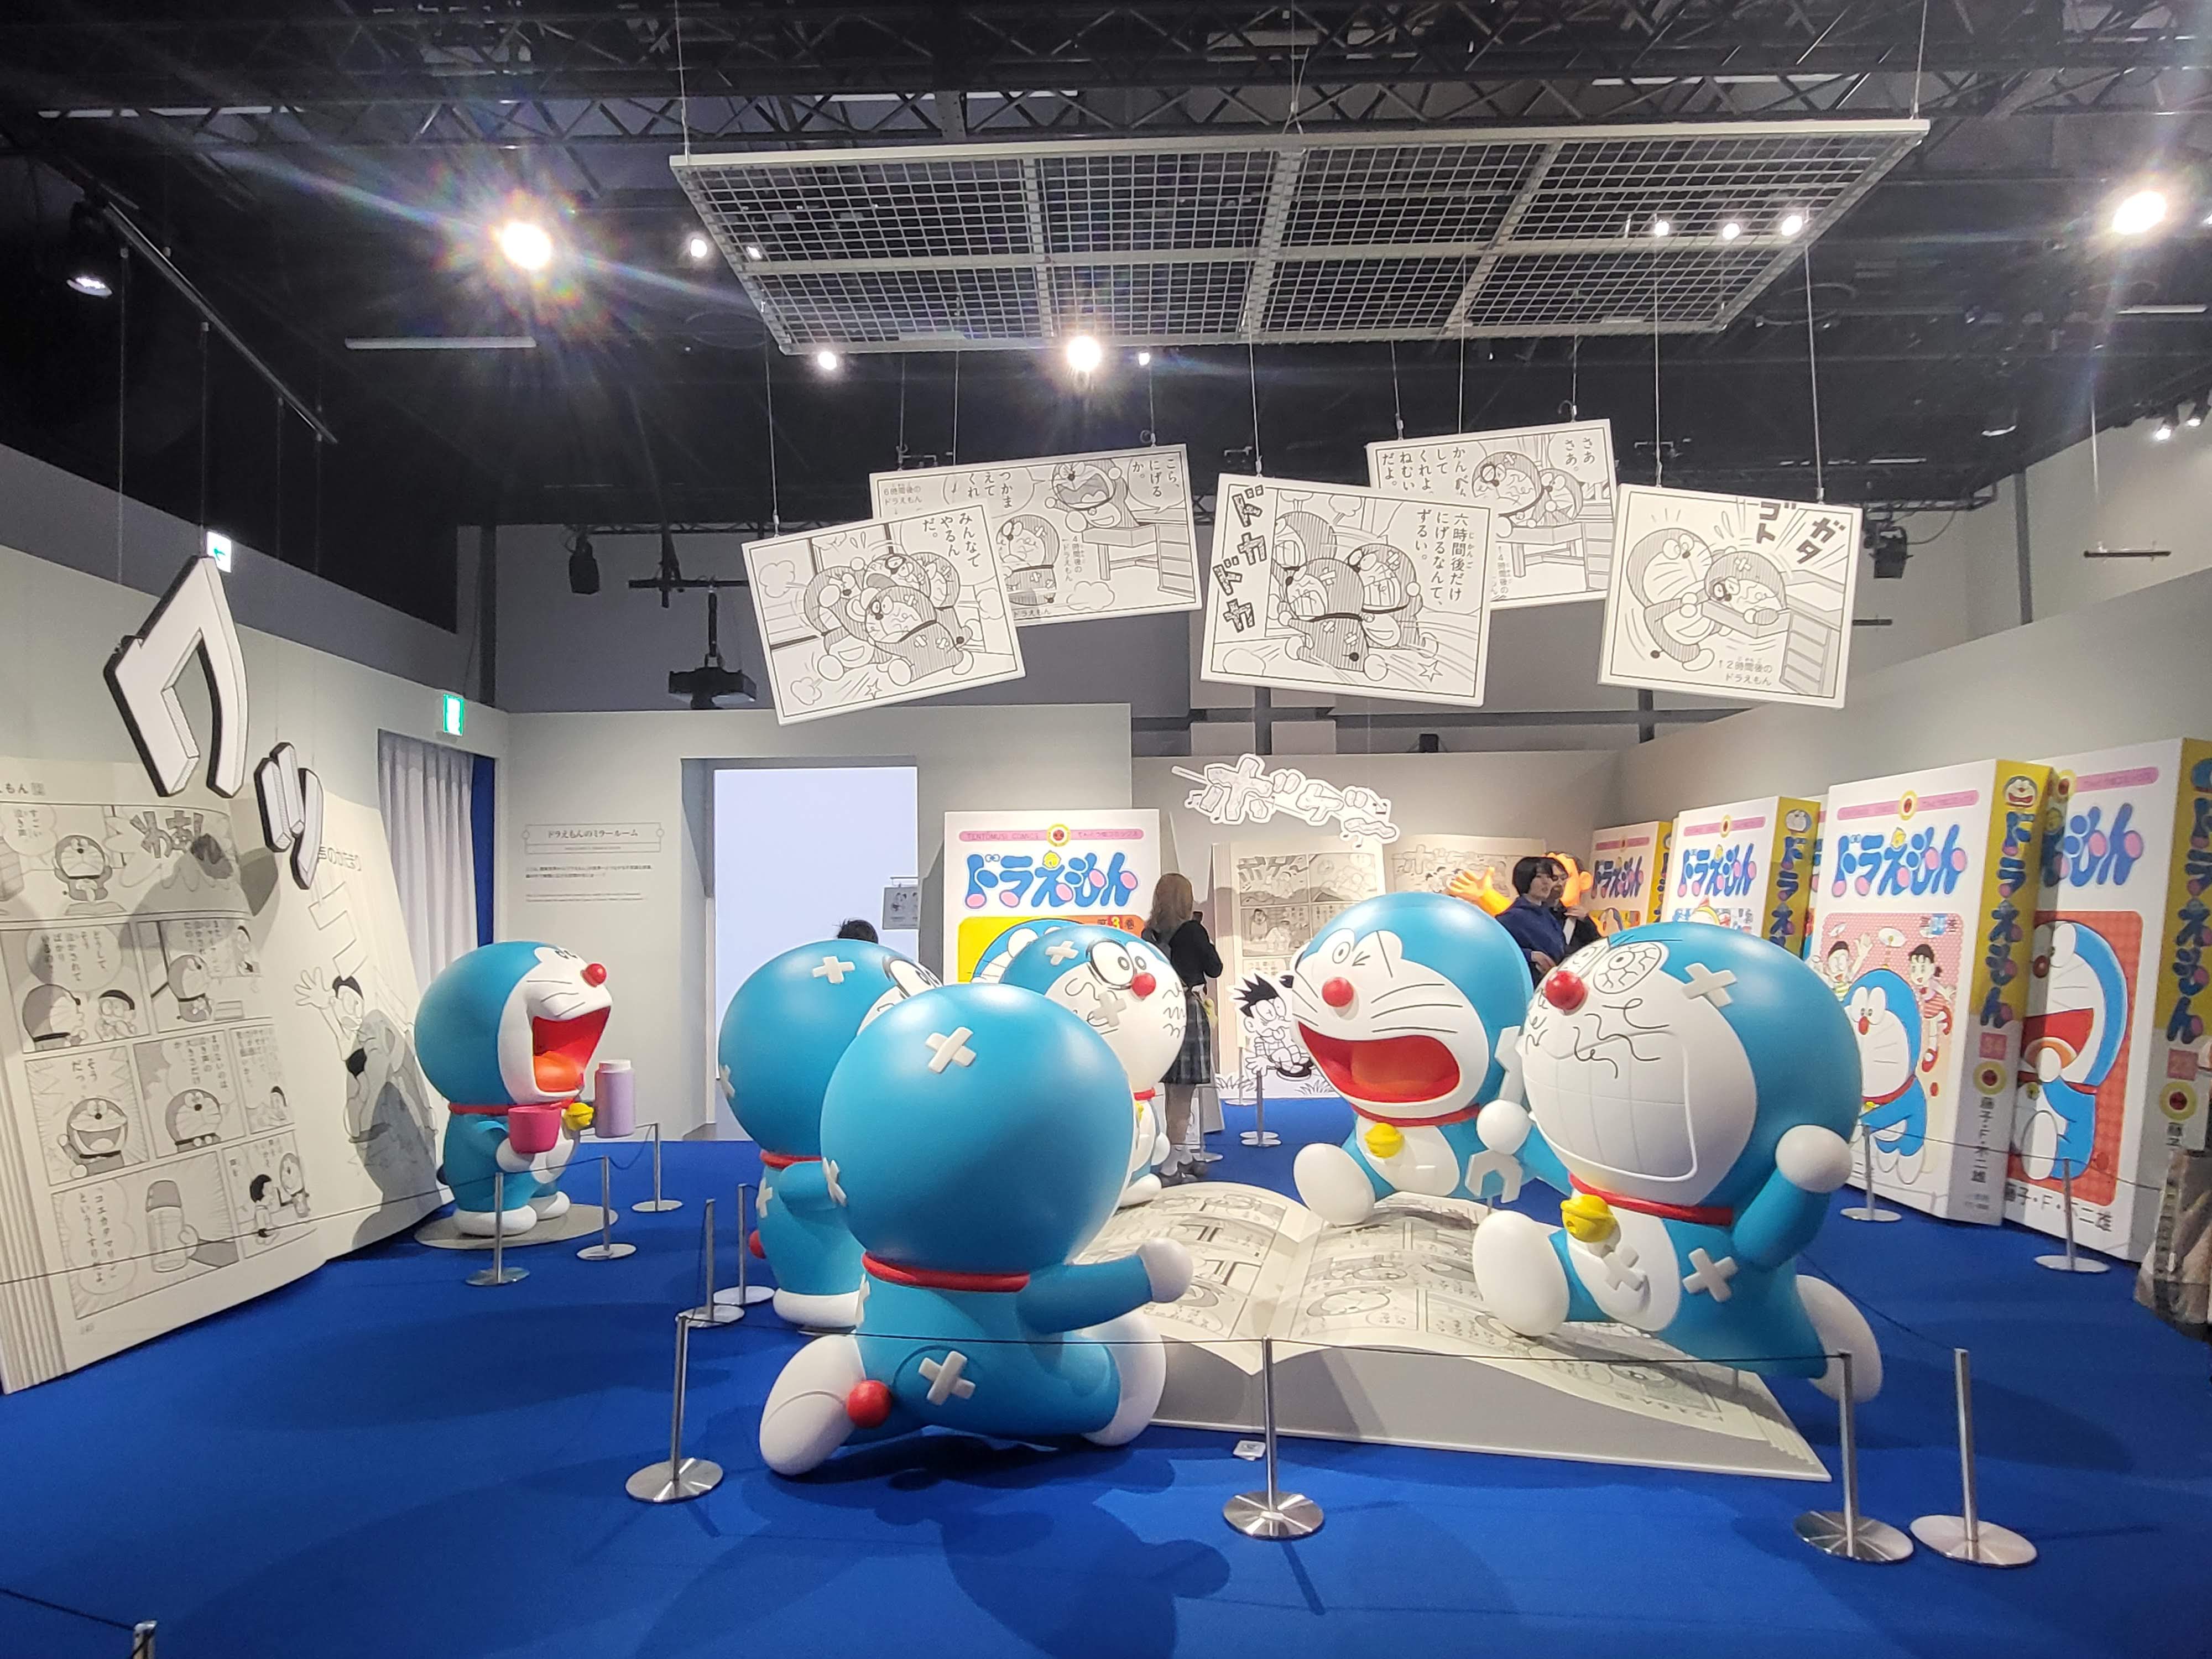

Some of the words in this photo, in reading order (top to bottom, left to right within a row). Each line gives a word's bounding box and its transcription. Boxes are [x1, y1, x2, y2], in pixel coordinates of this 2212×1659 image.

[1132, 461, 1145, 479] か。
[1382, 452, 1397, 487] だよ。
[1436, 448, 1448, 475] して
[1564, 439, 1579, 472] さあ。
[1583, 437, 1595, 465] さあ
[967, 473, 980, 498] くれ
[984, 471, 995, 497] えて
[999, 471, 1013, 509] つかま
[1149, 459, 1162, 498] にげる
[1166, 458, 1180, 488] こら、
[1400, 451, 1416, 491] ねむい
[884, 496, 922, 506] ドラえもん
[922, 518, 938, 538] だ。
[940, 515, 960, 557] やるん
[1415, 508, 1432, 560] ずるい。
[1756, 501, 1797, 544] ゴト
[1796, 517, 1846, 565] ガタ
[1430, 512, 1450, 606] にげるなんて、
[1449, 513, 1469, 602] 六時間後だけ
[1726, 673, 1772, 686] ドラえもん
[547, 829, 639, 839] ドラえもんのミラールーム
[1590, 855, 1645, 899] ドラえもん
[1677, 843, 1757, 898] ドラえもん
[1831, 823, 1968, 898] ドラえもん
[965, 852, 1139, 909] ドラえもん
[1980, 810, 2036, 1029] ドラえもん
